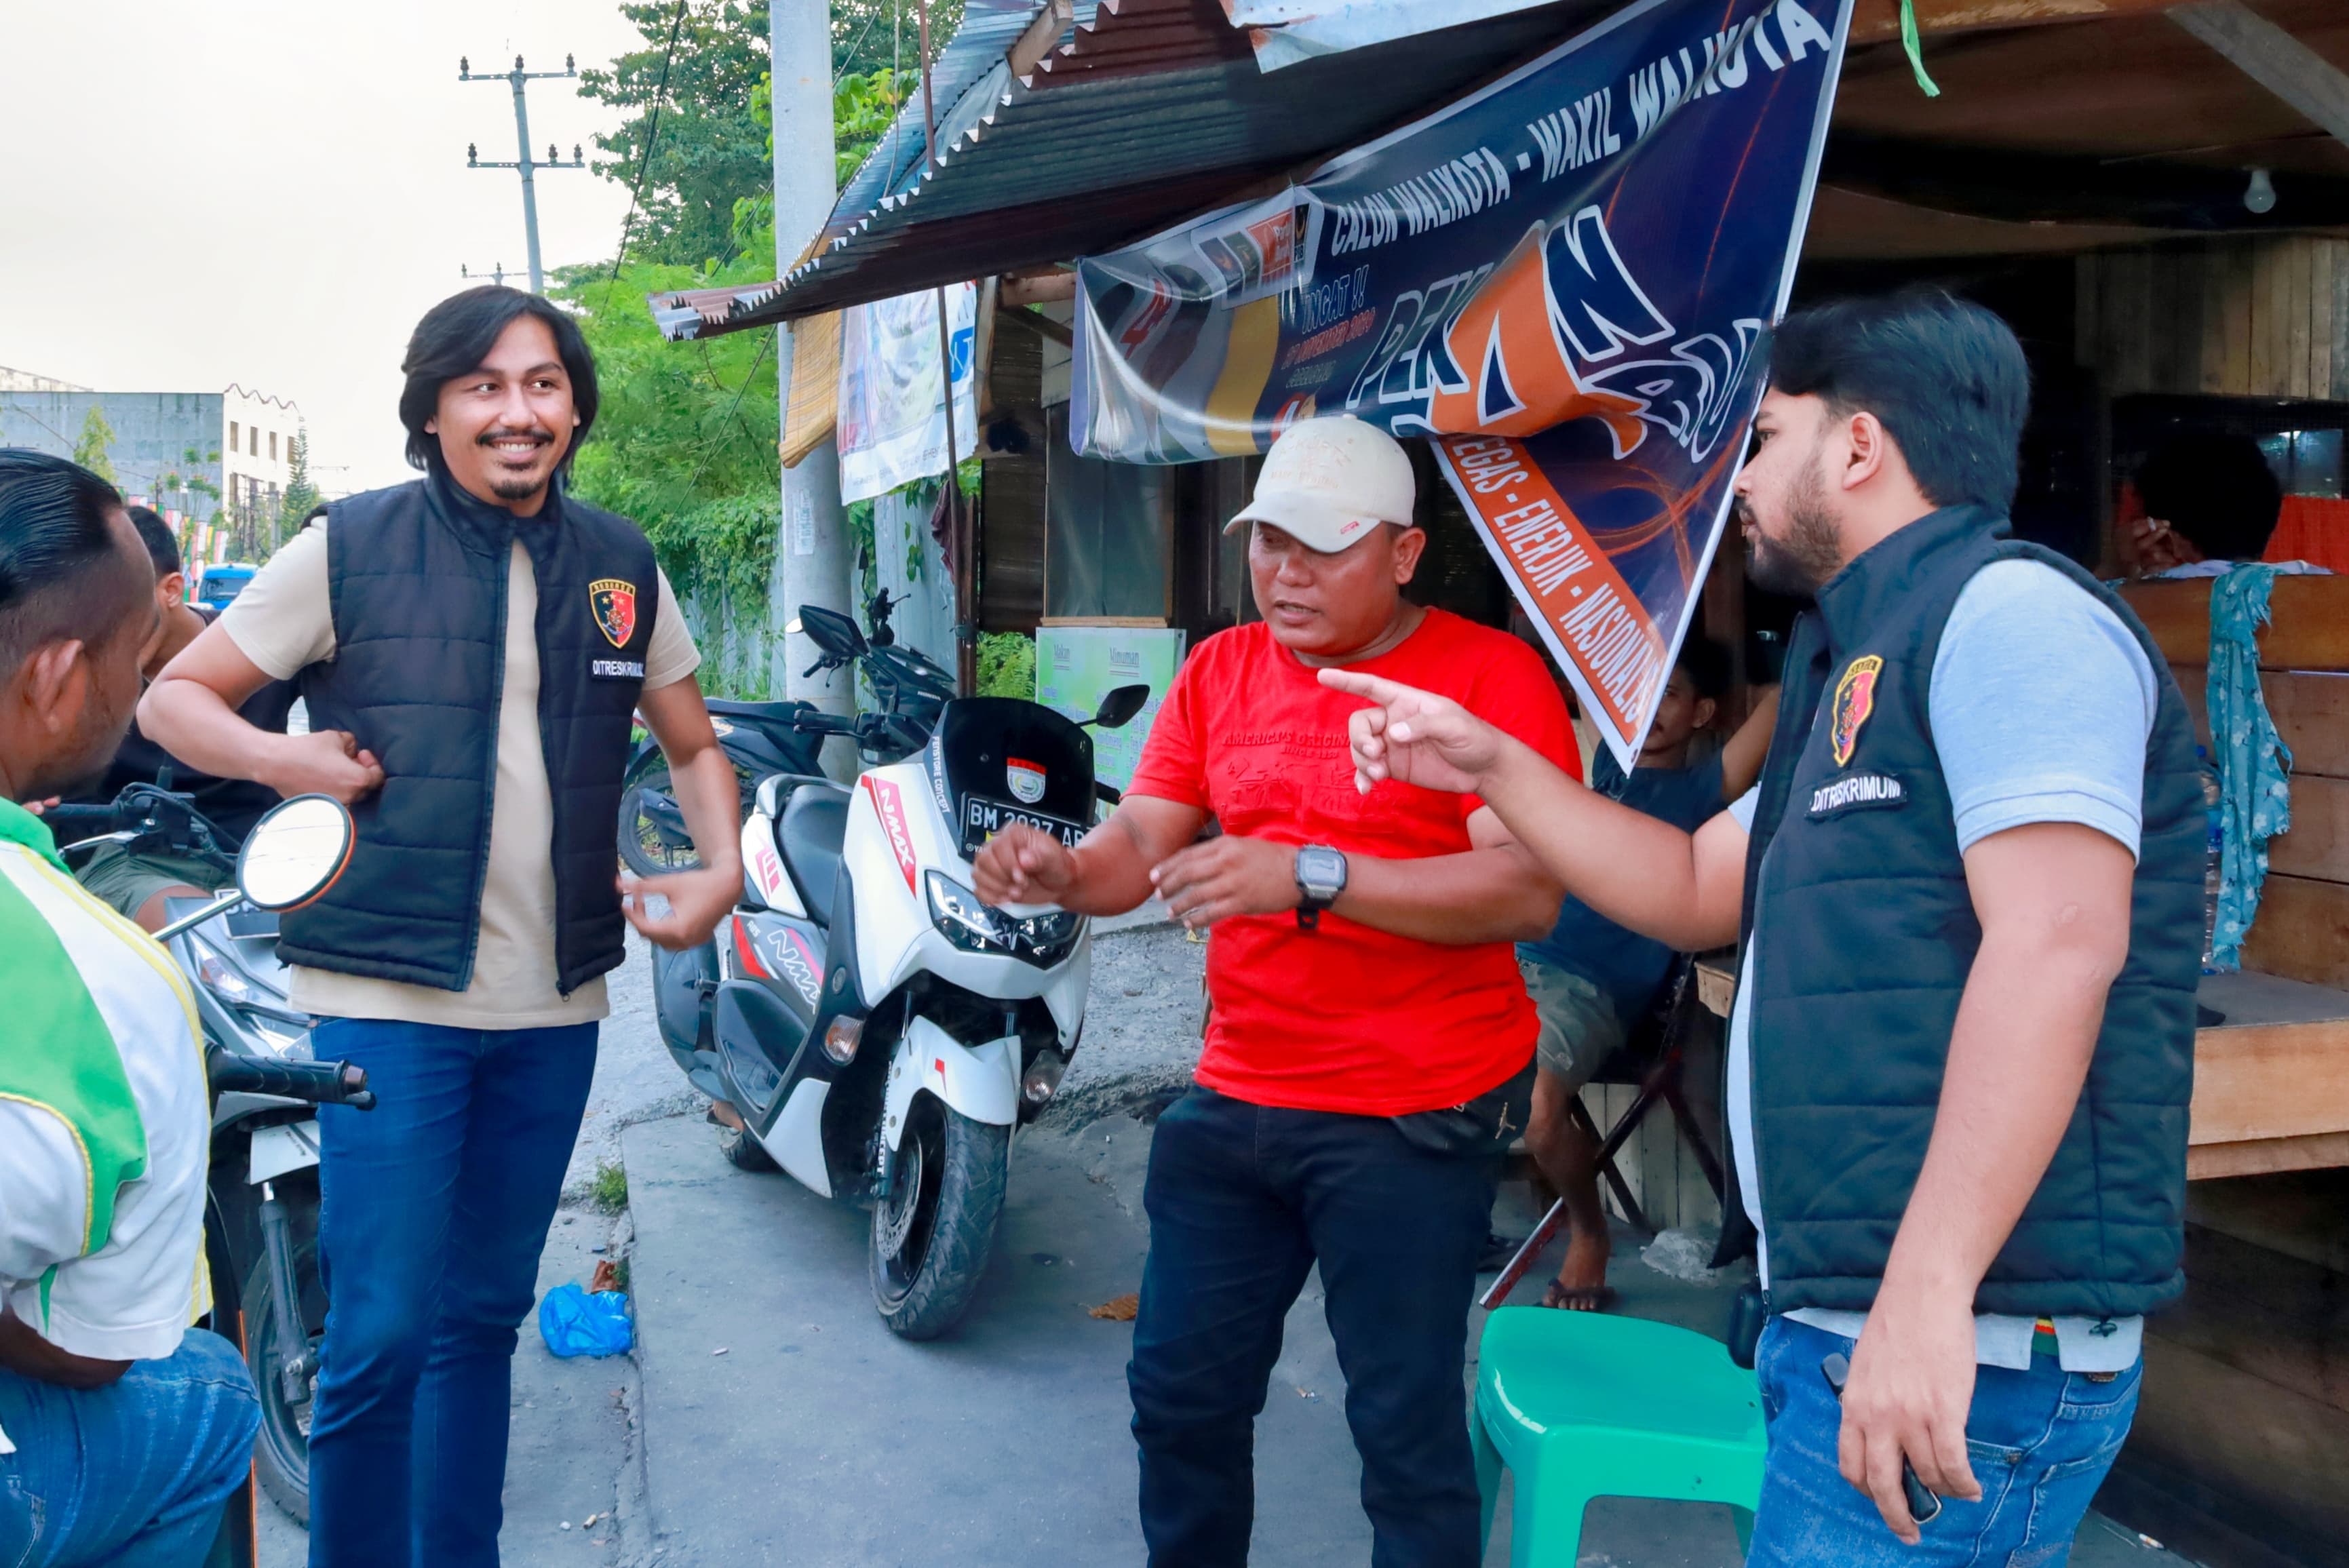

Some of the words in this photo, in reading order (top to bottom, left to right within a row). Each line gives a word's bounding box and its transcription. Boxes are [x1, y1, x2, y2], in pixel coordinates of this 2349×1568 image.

[1332, 192, 1398, 256] CALON
[1387, 146, 1511, 236] WALIKOTA
[1526, 86, 1620, 182] WAKIL
[1453, 437, 1529, 493] EGAS
[1494, 498, 1593, 597] ENERJIK
[882, 787, 914, 866] NMAX
[969, 803, 998, 830] BM
[767, 929, 821, 1015] NMA
